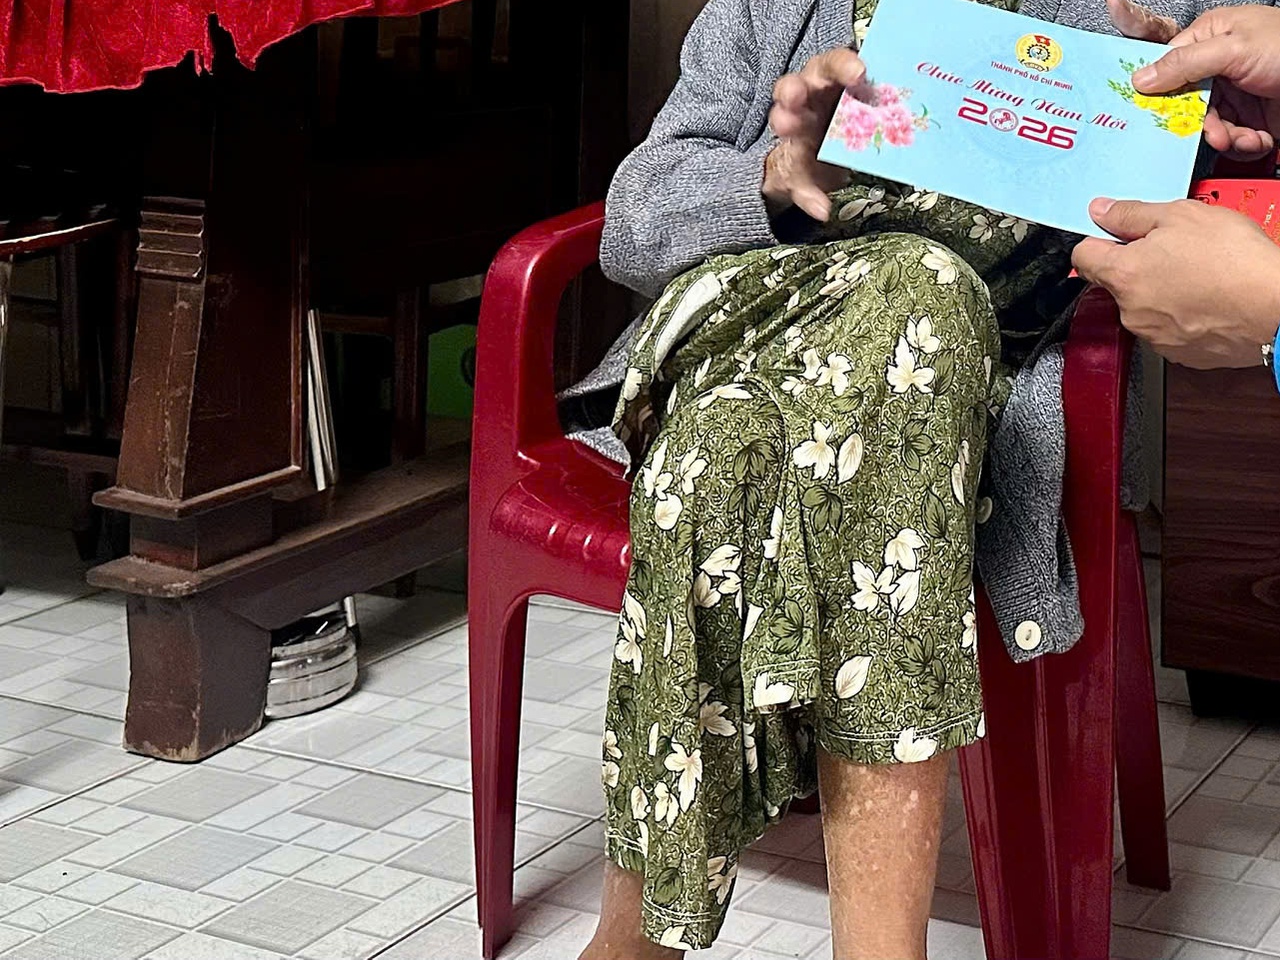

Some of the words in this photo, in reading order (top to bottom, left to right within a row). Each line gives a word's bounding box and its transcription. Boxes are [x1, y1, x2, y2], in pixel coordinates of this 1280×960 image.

[916, 61, 964, 86] Chúc
[966, 78, 1026, 107] Mừng
[1030, 97, 1083, 122] Năm
[1085, 111, 1128, 131] Mới
